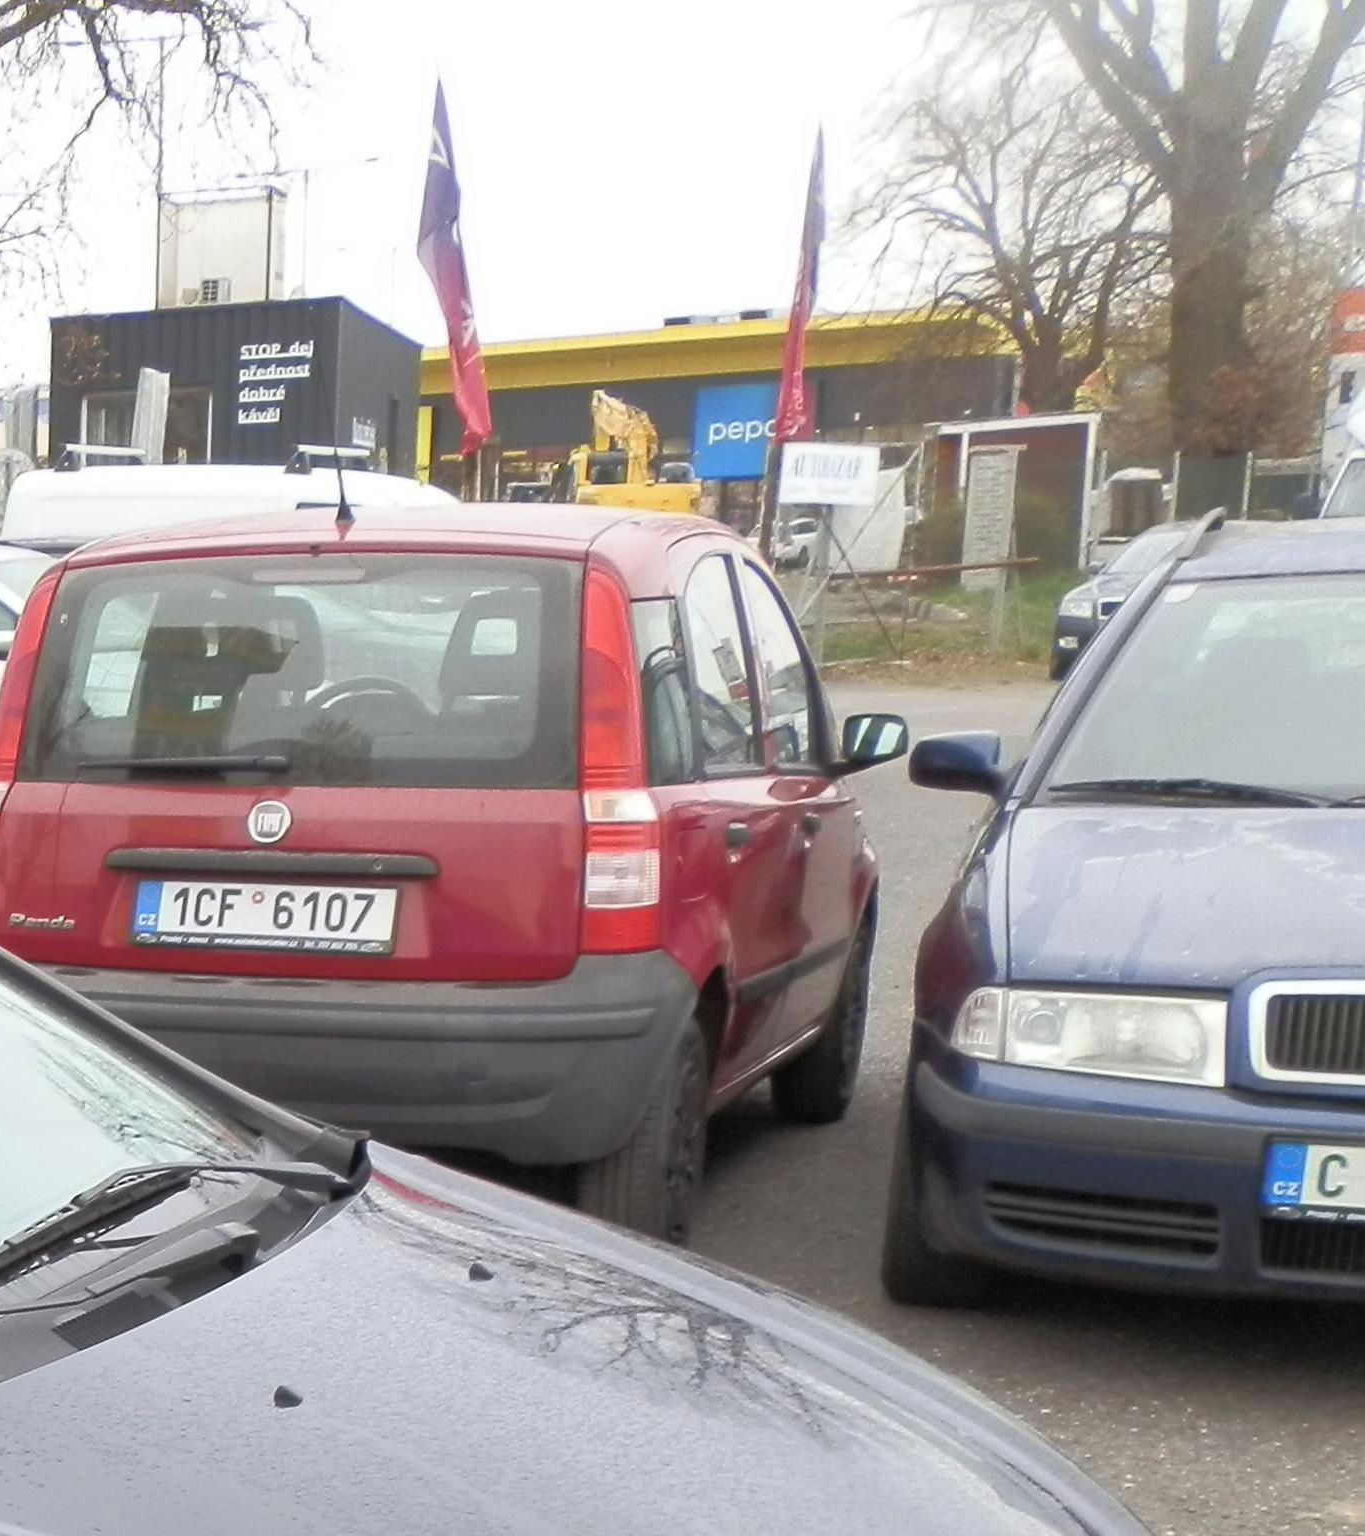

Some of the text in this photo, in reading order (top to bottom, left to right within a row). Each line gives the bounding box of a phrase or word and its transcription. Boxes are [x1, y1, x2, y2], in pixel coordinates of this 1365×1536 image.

[240, 339, 314, 358] STOP dej
[239, 364, 310, 384] přednost
[239, 385, 285, 402] dobré
[709, 416, 778, 445] pepc
[137, 887, 376, 934] CZ 1CF 6107
[8, 912, 75, 930] Panda
[1273, 1153, 1347, 1198] CZ C
